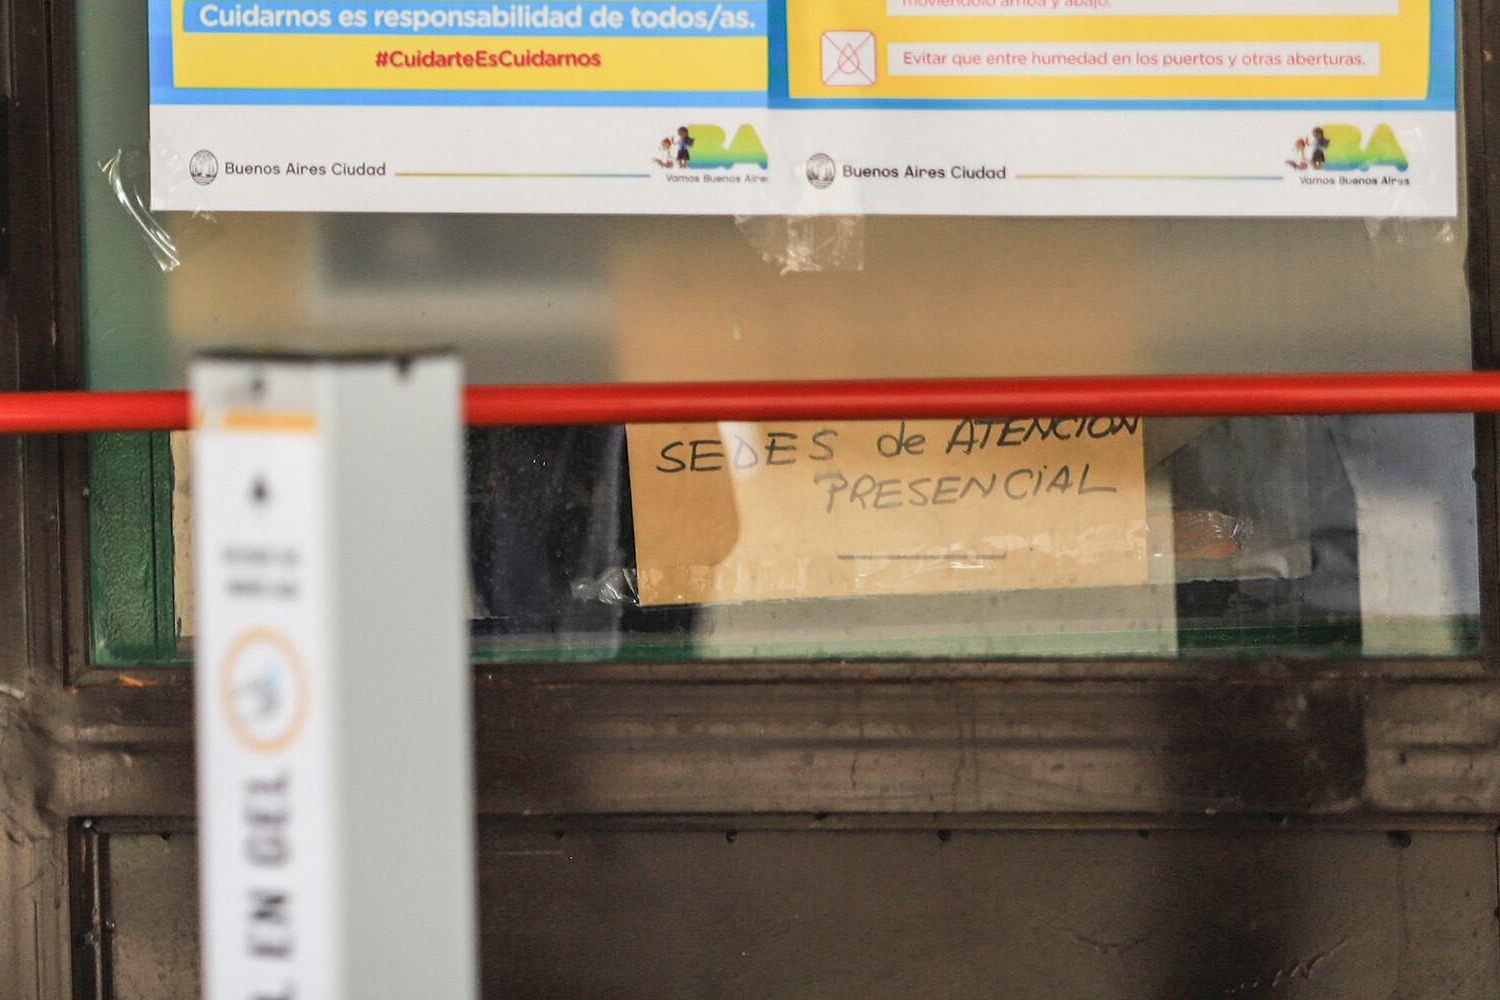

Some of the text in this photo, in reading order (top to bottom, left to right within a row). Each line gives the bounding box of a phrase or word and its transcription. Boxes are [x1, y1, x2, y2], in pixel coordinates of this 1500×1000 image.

[199, 3, 756, 32] Cuidarnos es responsabilidad de todos/as.
[375, 49, 602, 68] #CuidarteEsCuidarnos
[902, 50, 1365, 68] Evitar que entre humedad en los puertos y otras aberturas.
[687, 123, 768, 169] BA
[1323, 123, 1409, 172] BA
[224, 161, 386, 176] Buenos Aires Ciudad
[842, 165, 1006, 180] Buenos Aires Ciudad
[656, 429, 838, 473] SEDES
[877, 421, 926, 456] de
